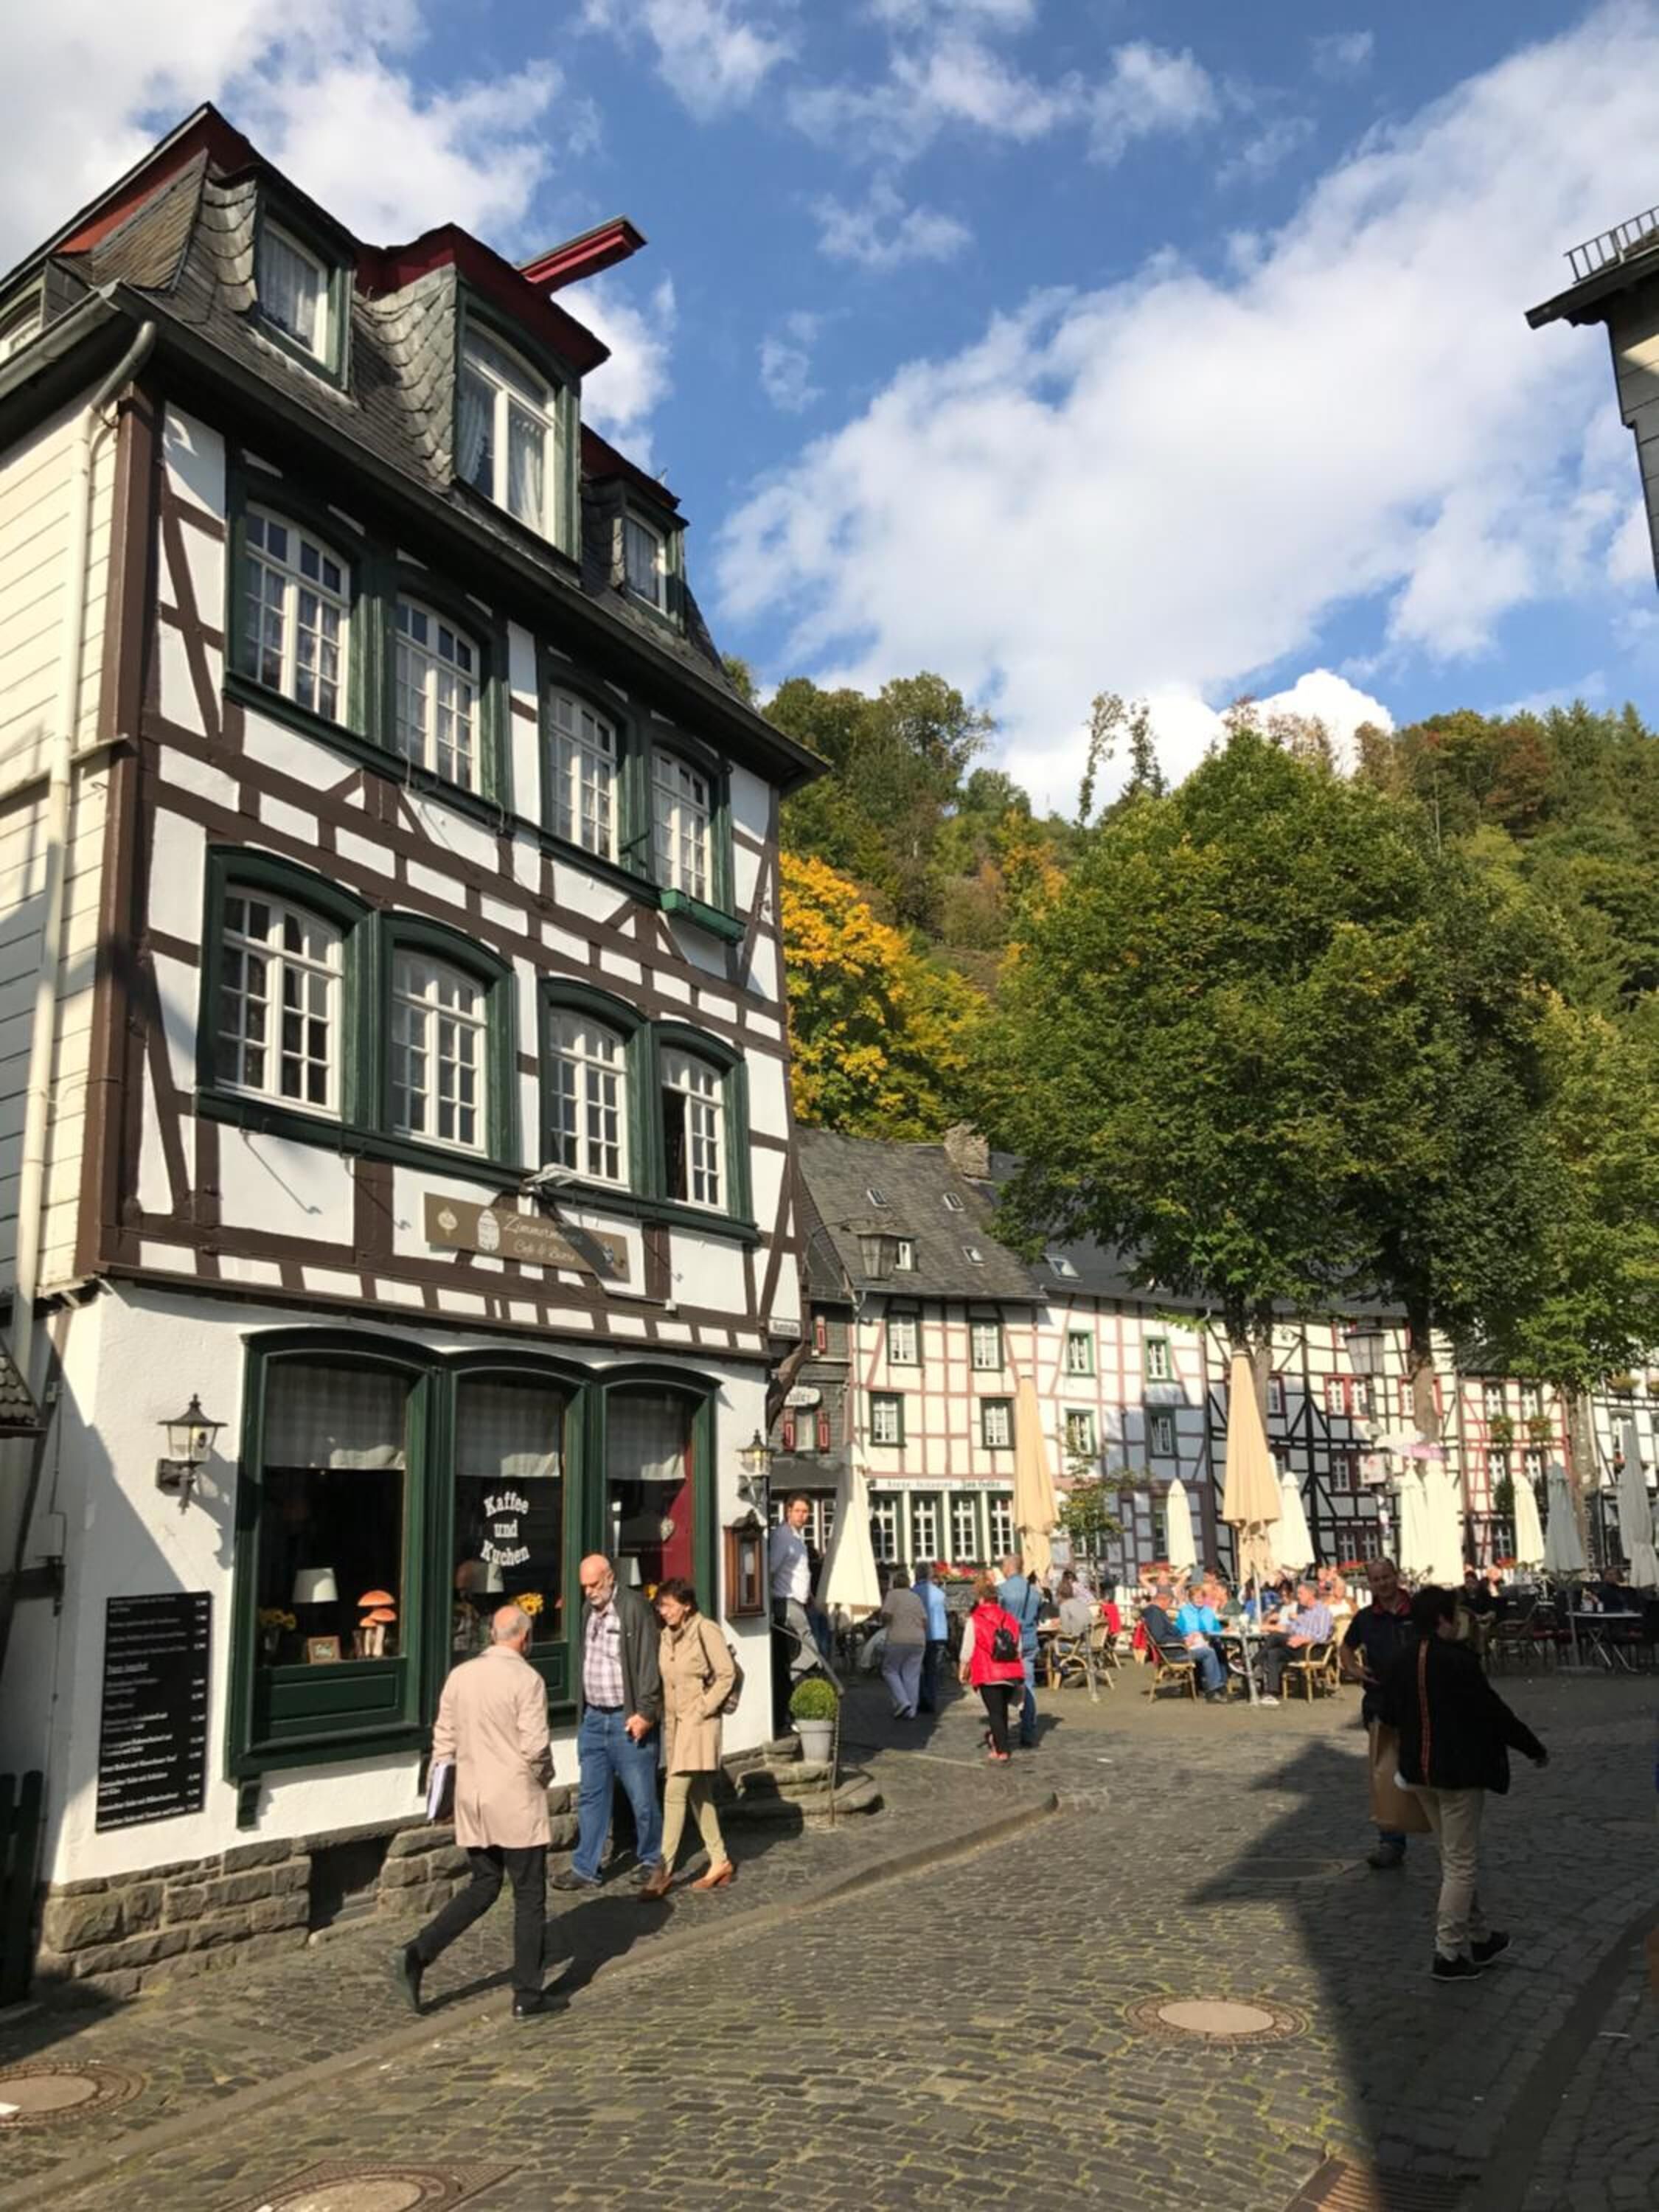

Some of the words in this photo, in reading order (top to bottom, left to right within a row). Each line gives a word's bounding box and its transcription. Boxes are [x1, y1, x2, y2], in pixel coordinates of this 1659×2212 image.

[483, 1491, 529, 1517] Kaffee
[493, 1519, 518, 1538] und
[480, 1540, 531, 1567] Kuchen
